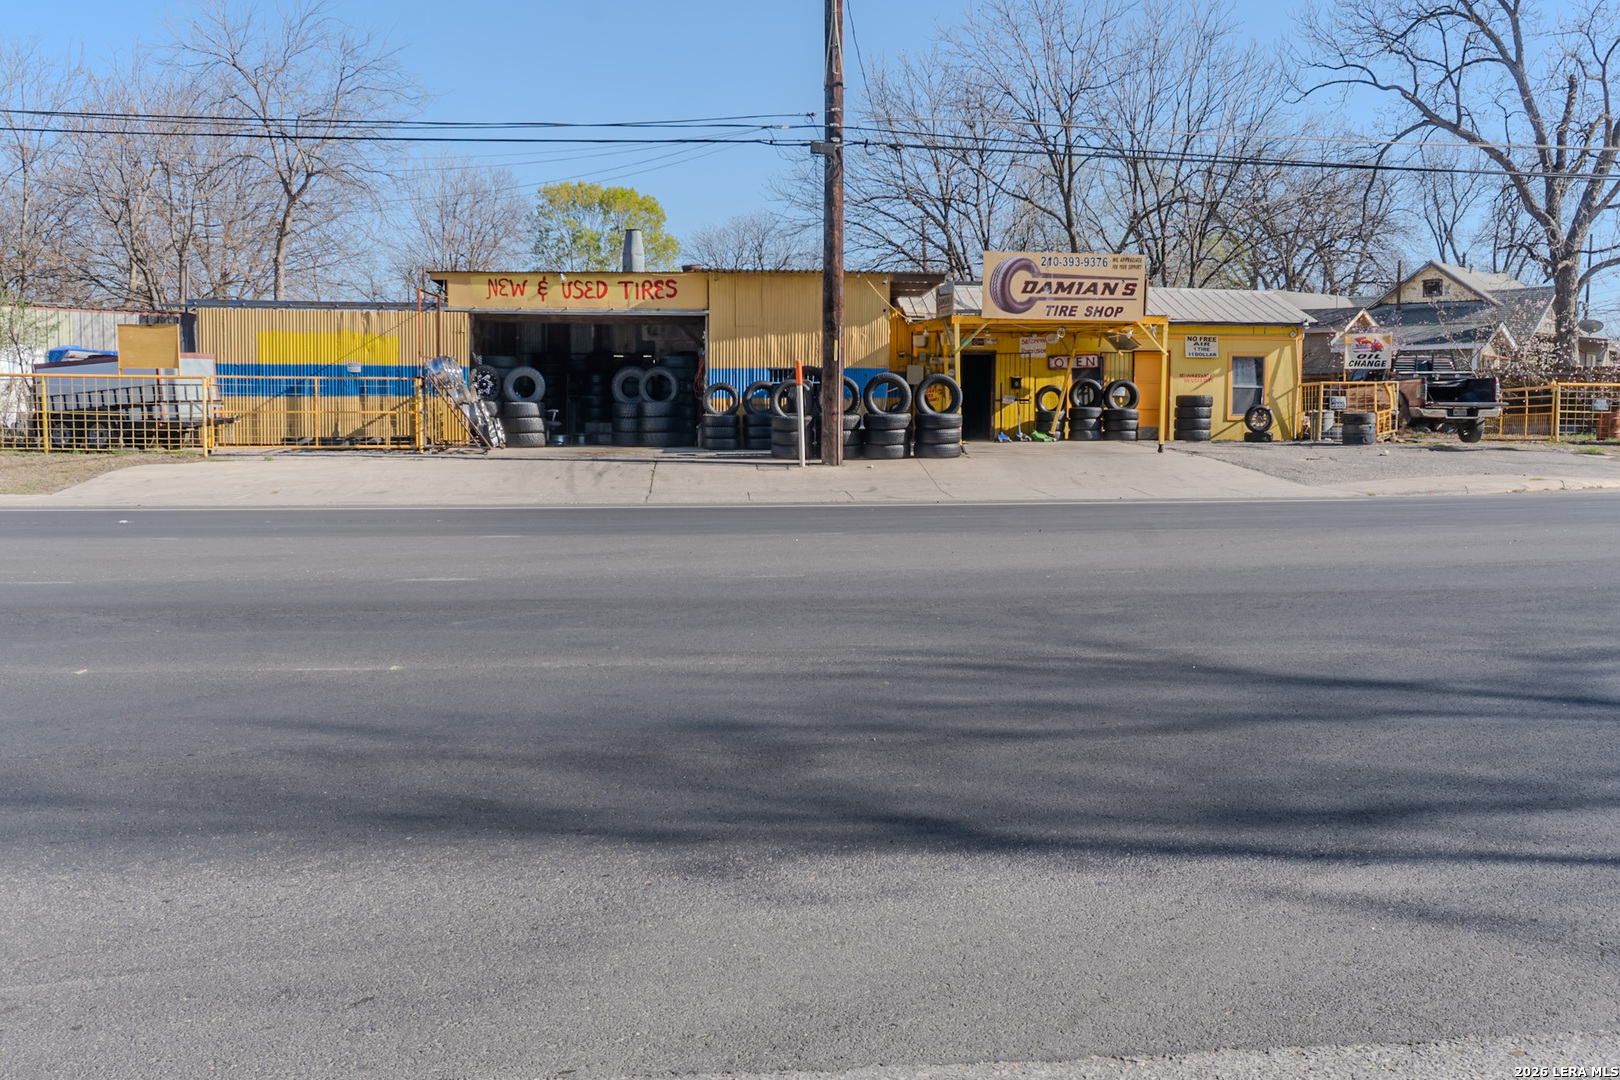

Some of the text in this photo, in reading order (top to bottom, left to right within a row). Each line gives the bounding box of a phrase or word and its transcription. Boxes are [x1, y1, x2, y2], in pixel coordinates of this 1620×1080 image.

[1040, 256, 1108, 268] 210-393-9376
[486, 276, 678, 302] NEW & USED TIRES
[1020, 279, 1138, 296] DAMIAN'S
[1046, 305, 1124, 318] TIRE SHOP
[1054, 356, 1096, 368] OEN
